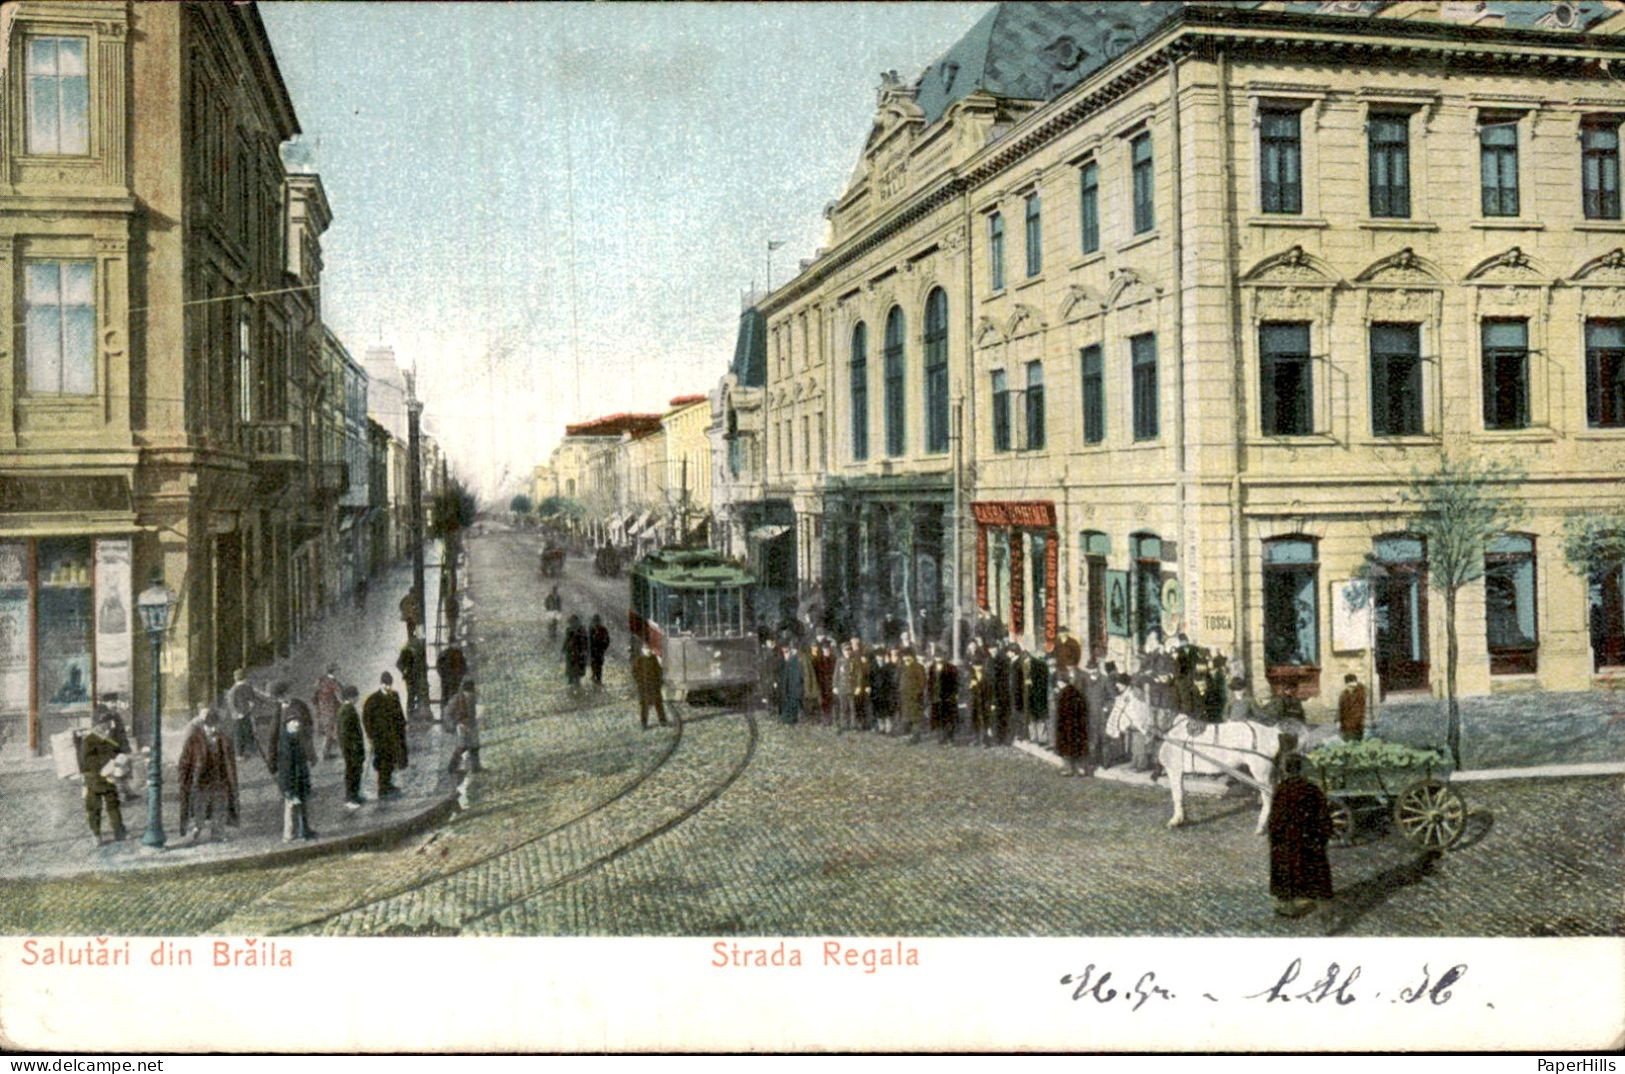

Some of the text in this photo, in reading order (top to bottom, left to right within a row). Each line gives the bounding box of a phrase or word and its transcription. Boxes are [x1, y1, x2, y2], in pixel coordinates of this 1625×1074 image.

[1203, 615, 1232, 631] TOSCA
[150, 940, 192, 966] din
[711, 941, 919, 975] Strada Regala
